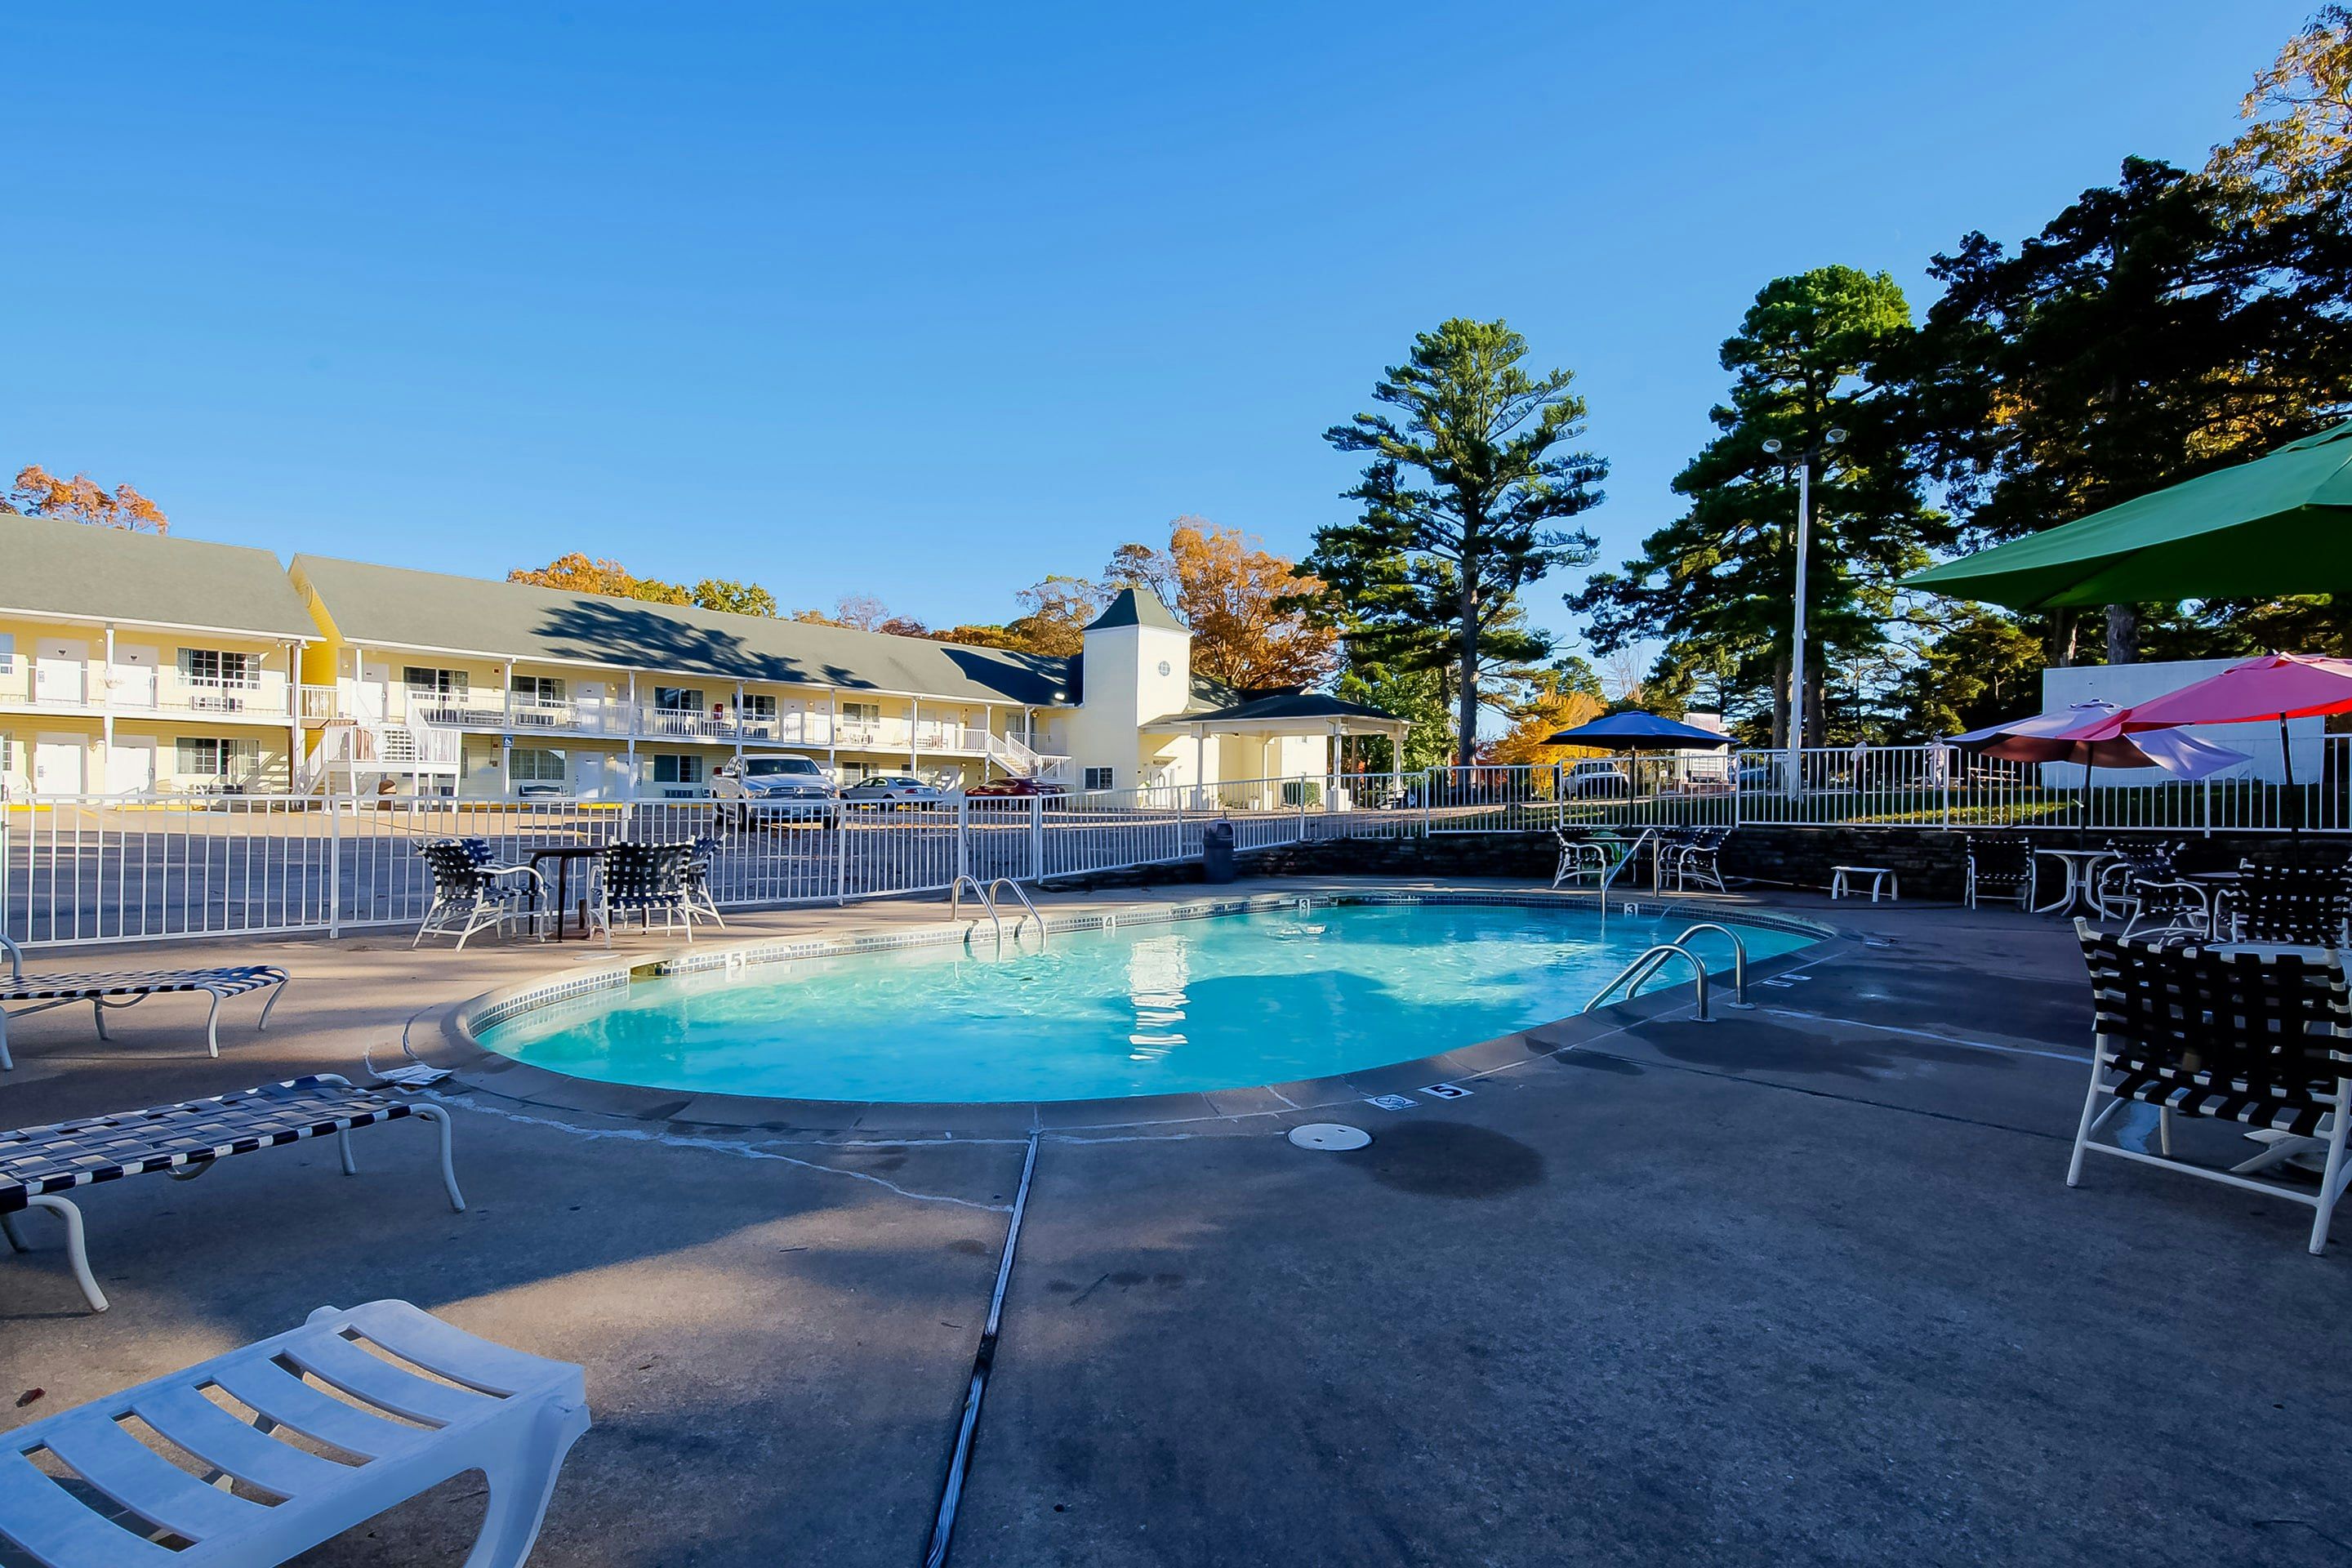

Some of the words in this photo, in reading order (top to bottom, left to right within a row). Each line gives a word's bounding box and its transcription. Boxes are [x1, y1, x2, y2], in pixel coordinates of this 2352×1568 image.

[1626, 903, 1636, 914] 3
[1105, 916, 1113, 927] 4
[731, 952, 742, 967] 5
[1428, 1085, 1463, 1097] 5
